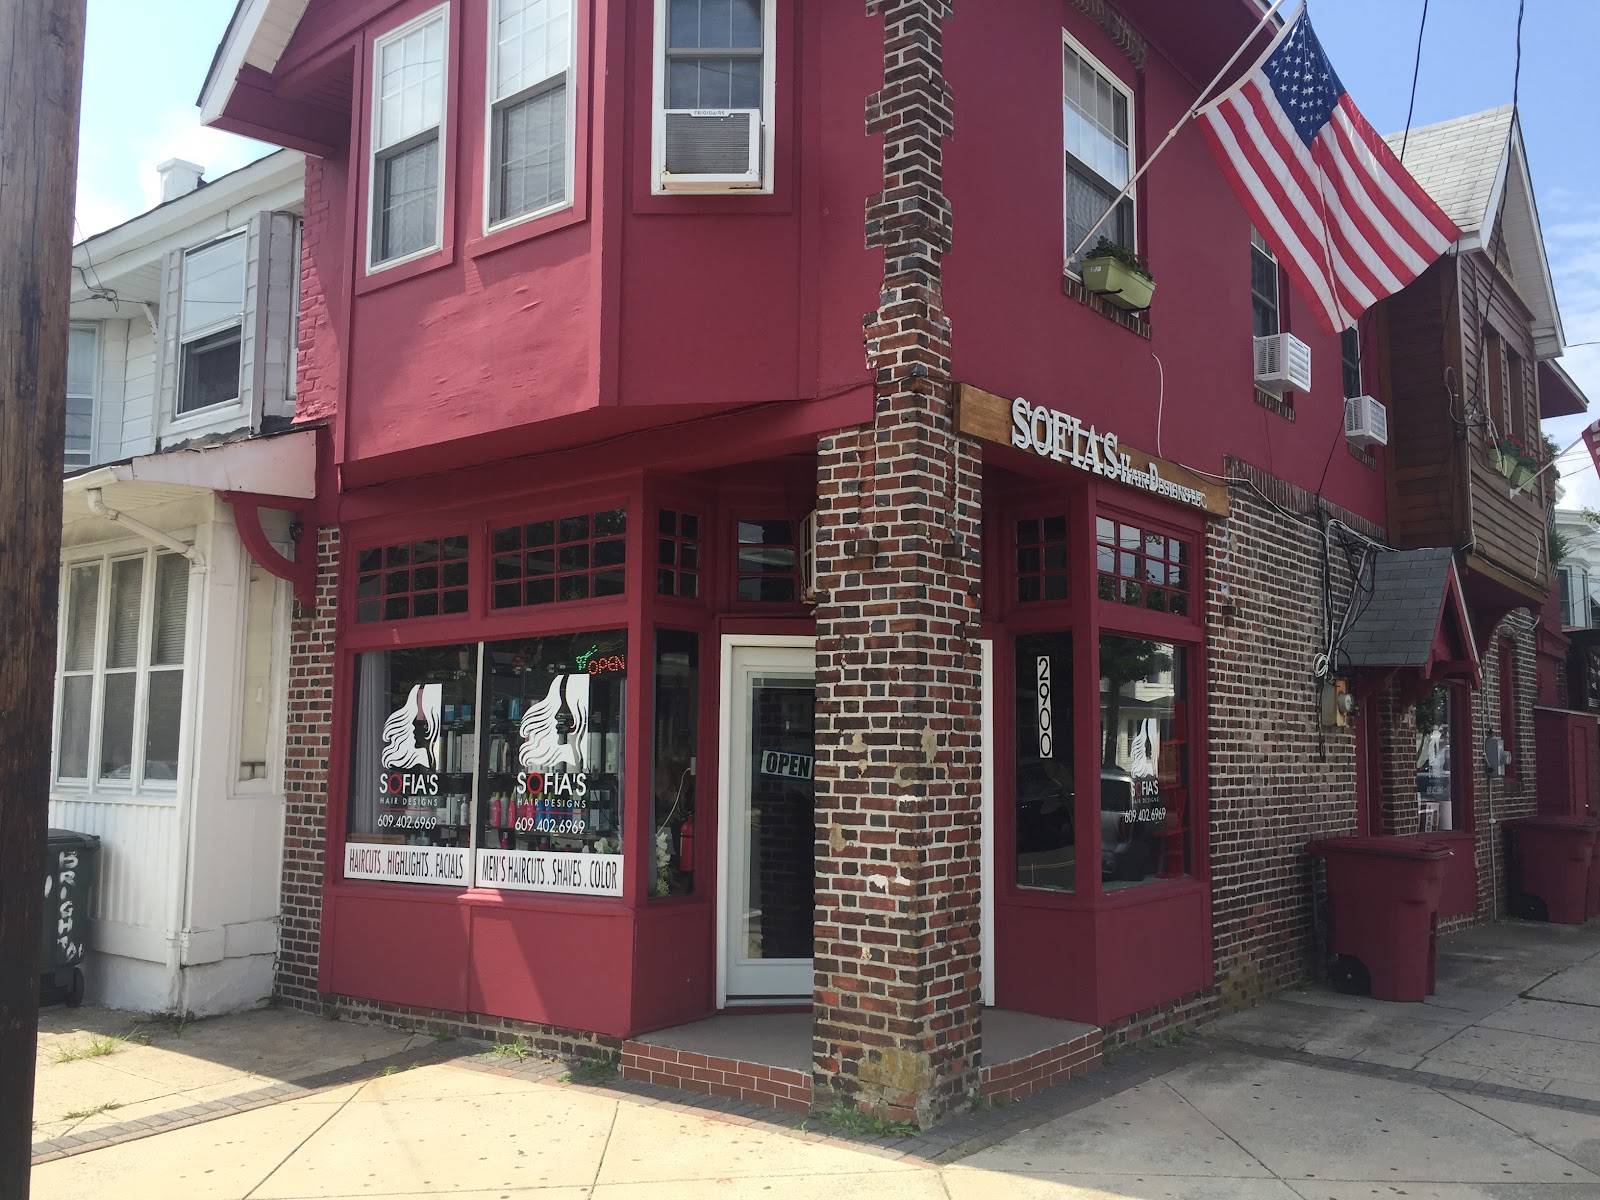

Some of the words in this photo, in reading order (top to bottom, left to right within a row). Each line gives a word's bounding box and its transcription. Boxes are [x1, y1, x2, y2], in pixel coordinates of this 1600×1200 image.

[588, 655, 625, 674] OPEN
[1037, 657, 1052, 757] 2900
[765, 752, 811, 778] OPEN
[379, 772, 439, 795] SOFIA'S
[516, 771, 587, 796] SOFIA'S
[379, 797, 398, 805] HAIR
[402, 798, 438, 807] DESIGNS
[517, 798, 539, 807] HAIR
[544, 799, 587, 809] DESIGNS
[377, 814, 437, 830] 609.402.6969
[514, 816, 586, 835] 609.402.6969
[1124, 807, 1167, 824] 609.402.6969
[349, 848, 381, 875] HAIRCUTS
[386, 850, 429, 878] HIGHLIGHTS
[435, 852, 464, 880] FACIALS
[482, 855, 506, 883] MEN'S
[507, 856, 546, 885] HAIRCUTS
[552, 858, 582, 888] SHAVES
[589, 860, 618, 890] COLOR
